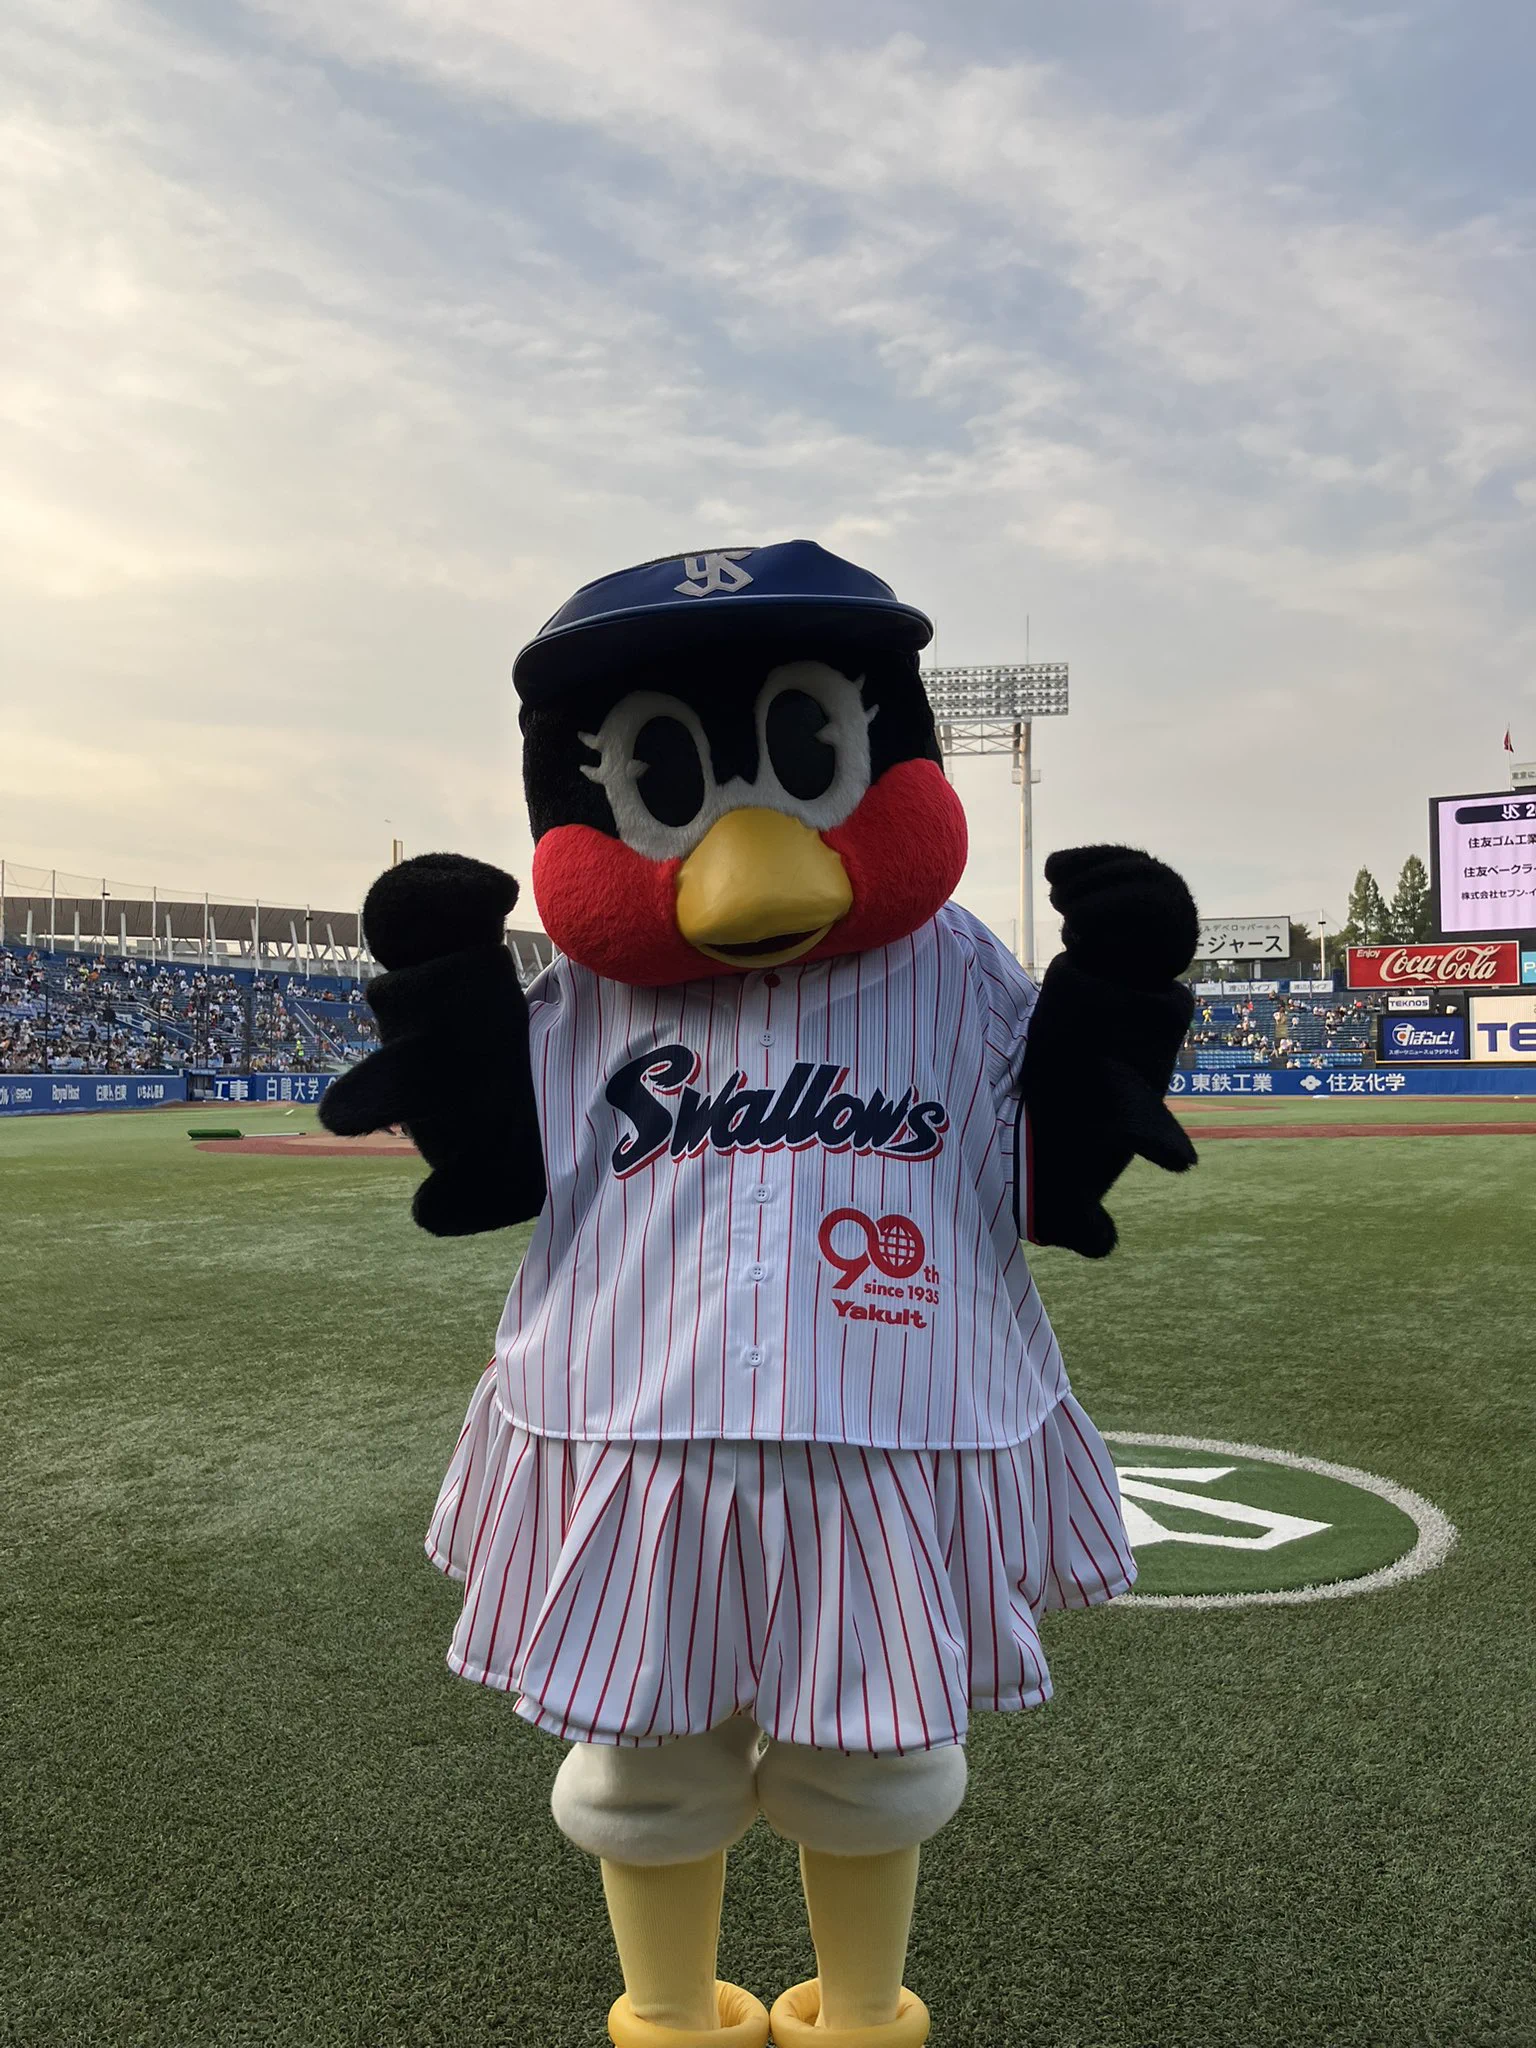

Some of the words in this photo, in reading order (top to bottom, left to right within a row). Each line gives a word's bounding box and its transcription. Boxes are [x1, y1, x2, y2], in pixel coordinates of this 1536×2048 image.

[1526, 803, 1536, 818] 2
[1464, 863, 1536, 878] 住友ベークラ
[1356, 949, 1380, 958] Enjoy
[1379, 945, 1502, 982] Coca-Cola
[1191, 1073, 1273, 1093] 東鉄工業
[1326, 1073, 1406, 1092] 住友化学
[602, 1044, 951, 1181] Swallows
[864, 1279, 905, 1299] since
[907, 1285, 940, 1306] 1935
[831, 1298, 928, 1329] Yakult
